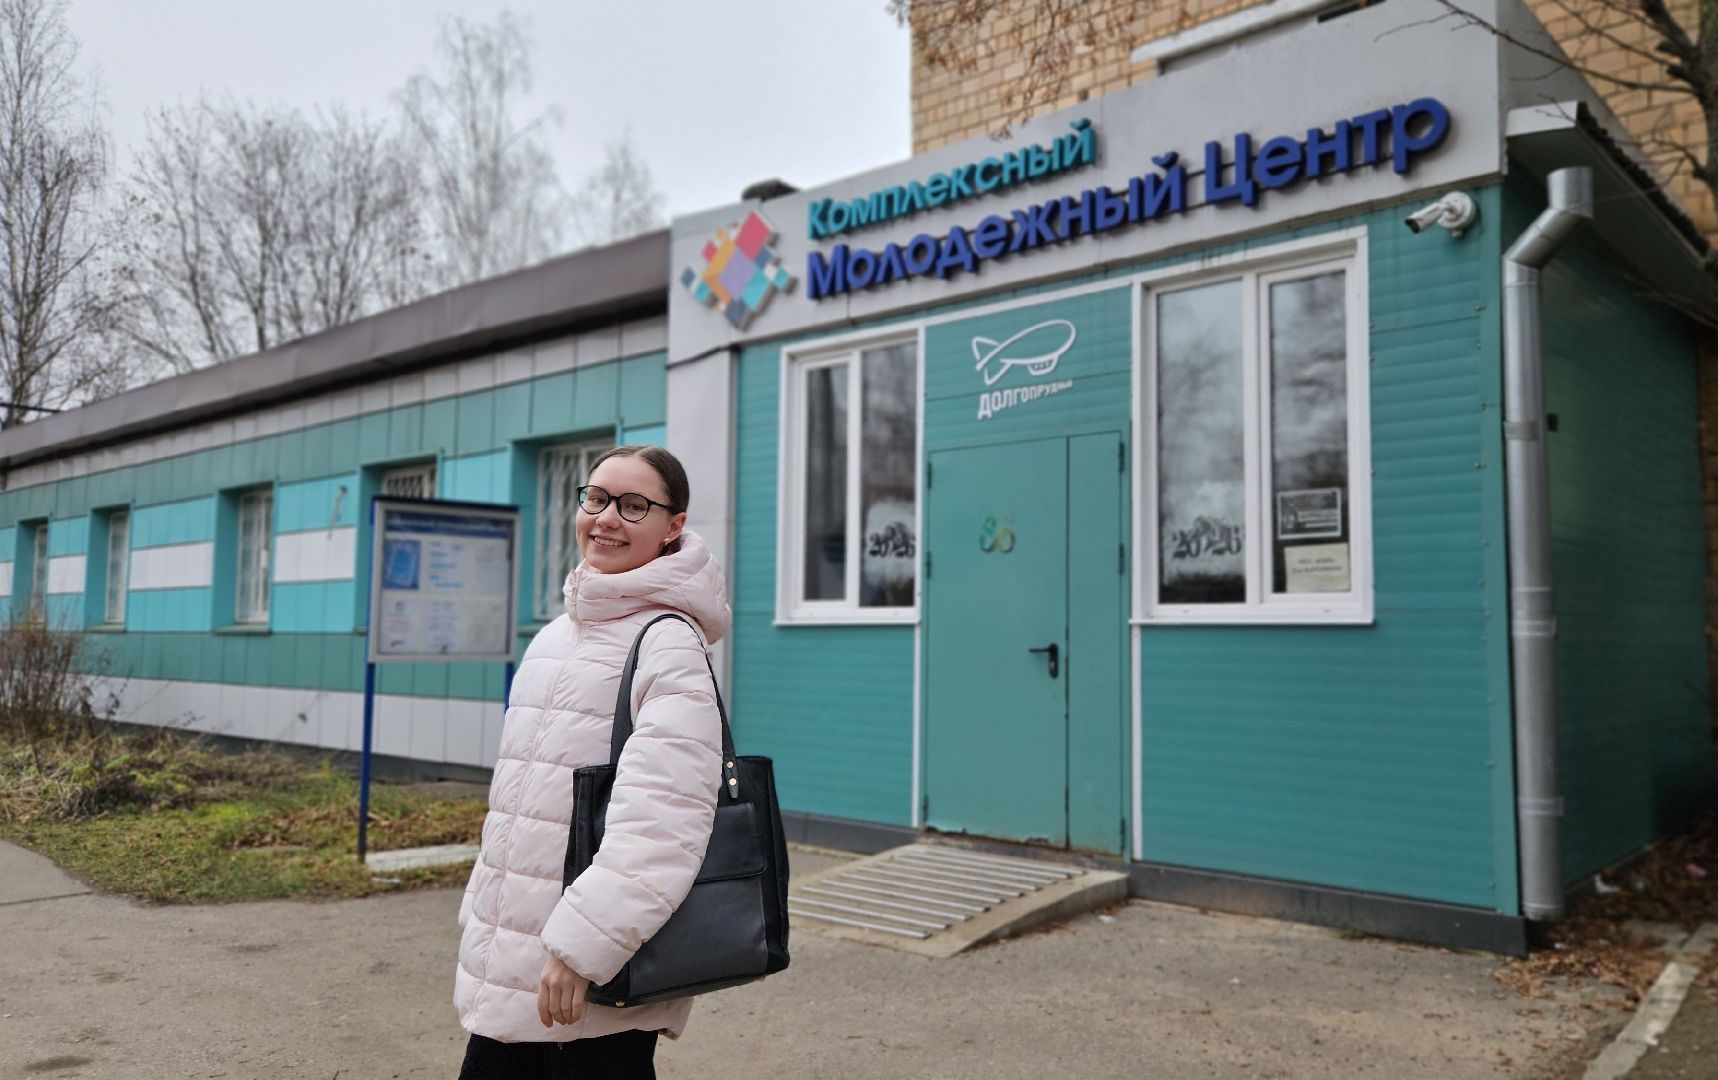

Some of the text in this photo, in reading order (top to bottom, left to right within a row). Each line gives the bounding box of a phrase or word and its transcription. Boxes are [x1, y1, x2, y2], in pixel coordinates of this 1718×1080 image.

[806, 97, 1450, 300] Молодежный Центр
[807, 117, 1096, 240] Комплексный
